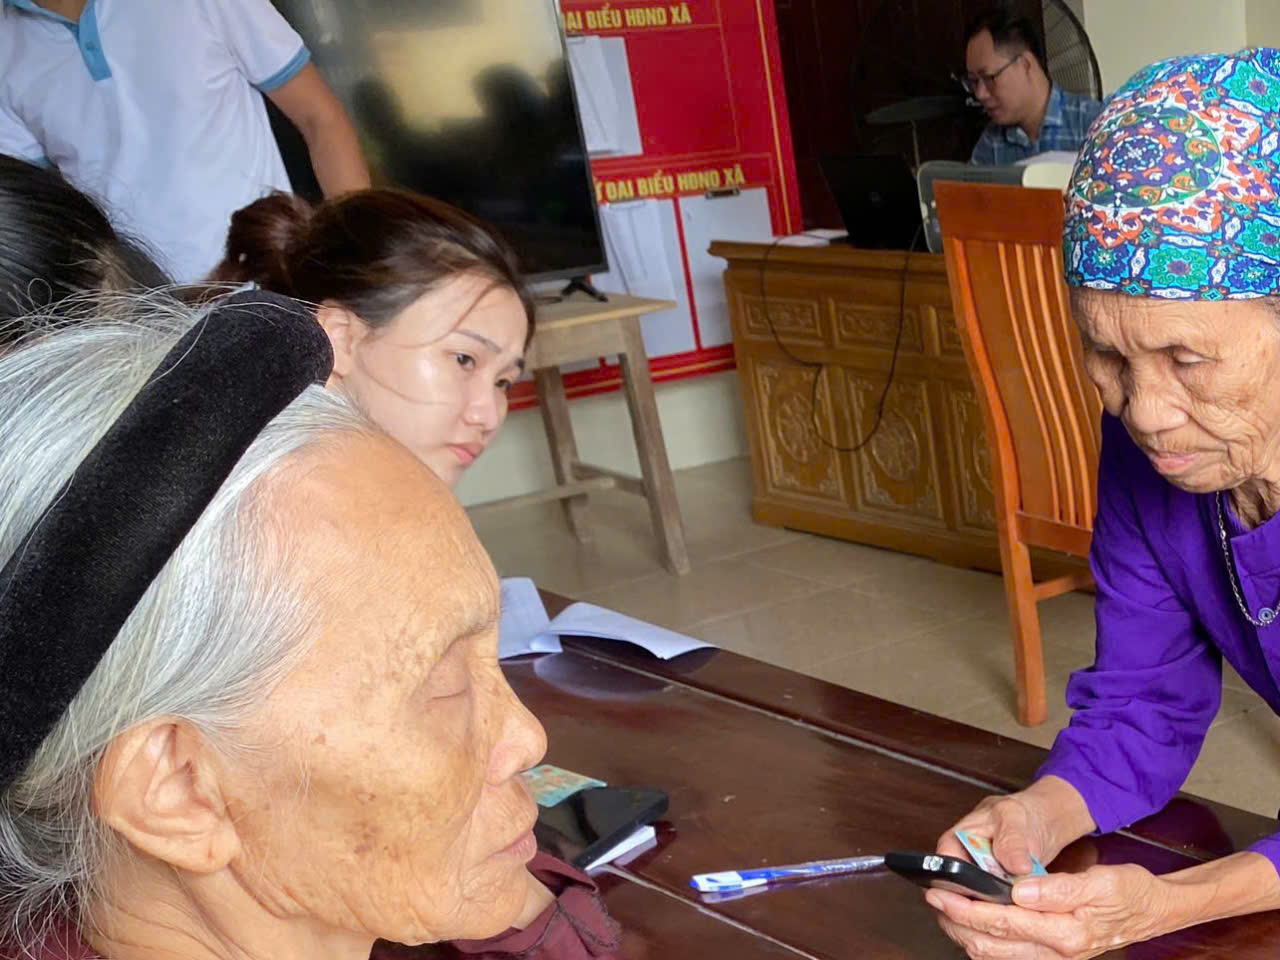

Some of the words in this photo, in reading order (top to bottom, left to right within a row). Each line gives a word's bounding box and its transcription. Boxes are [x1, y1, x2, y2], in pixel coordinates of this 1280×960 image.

[585, 3, 622, 29] BIỂU
[670, 2, 692, 25] XÃ
[637, 168, 675, 196] BIỂU
[723, 163, 744, 186] XÃ
